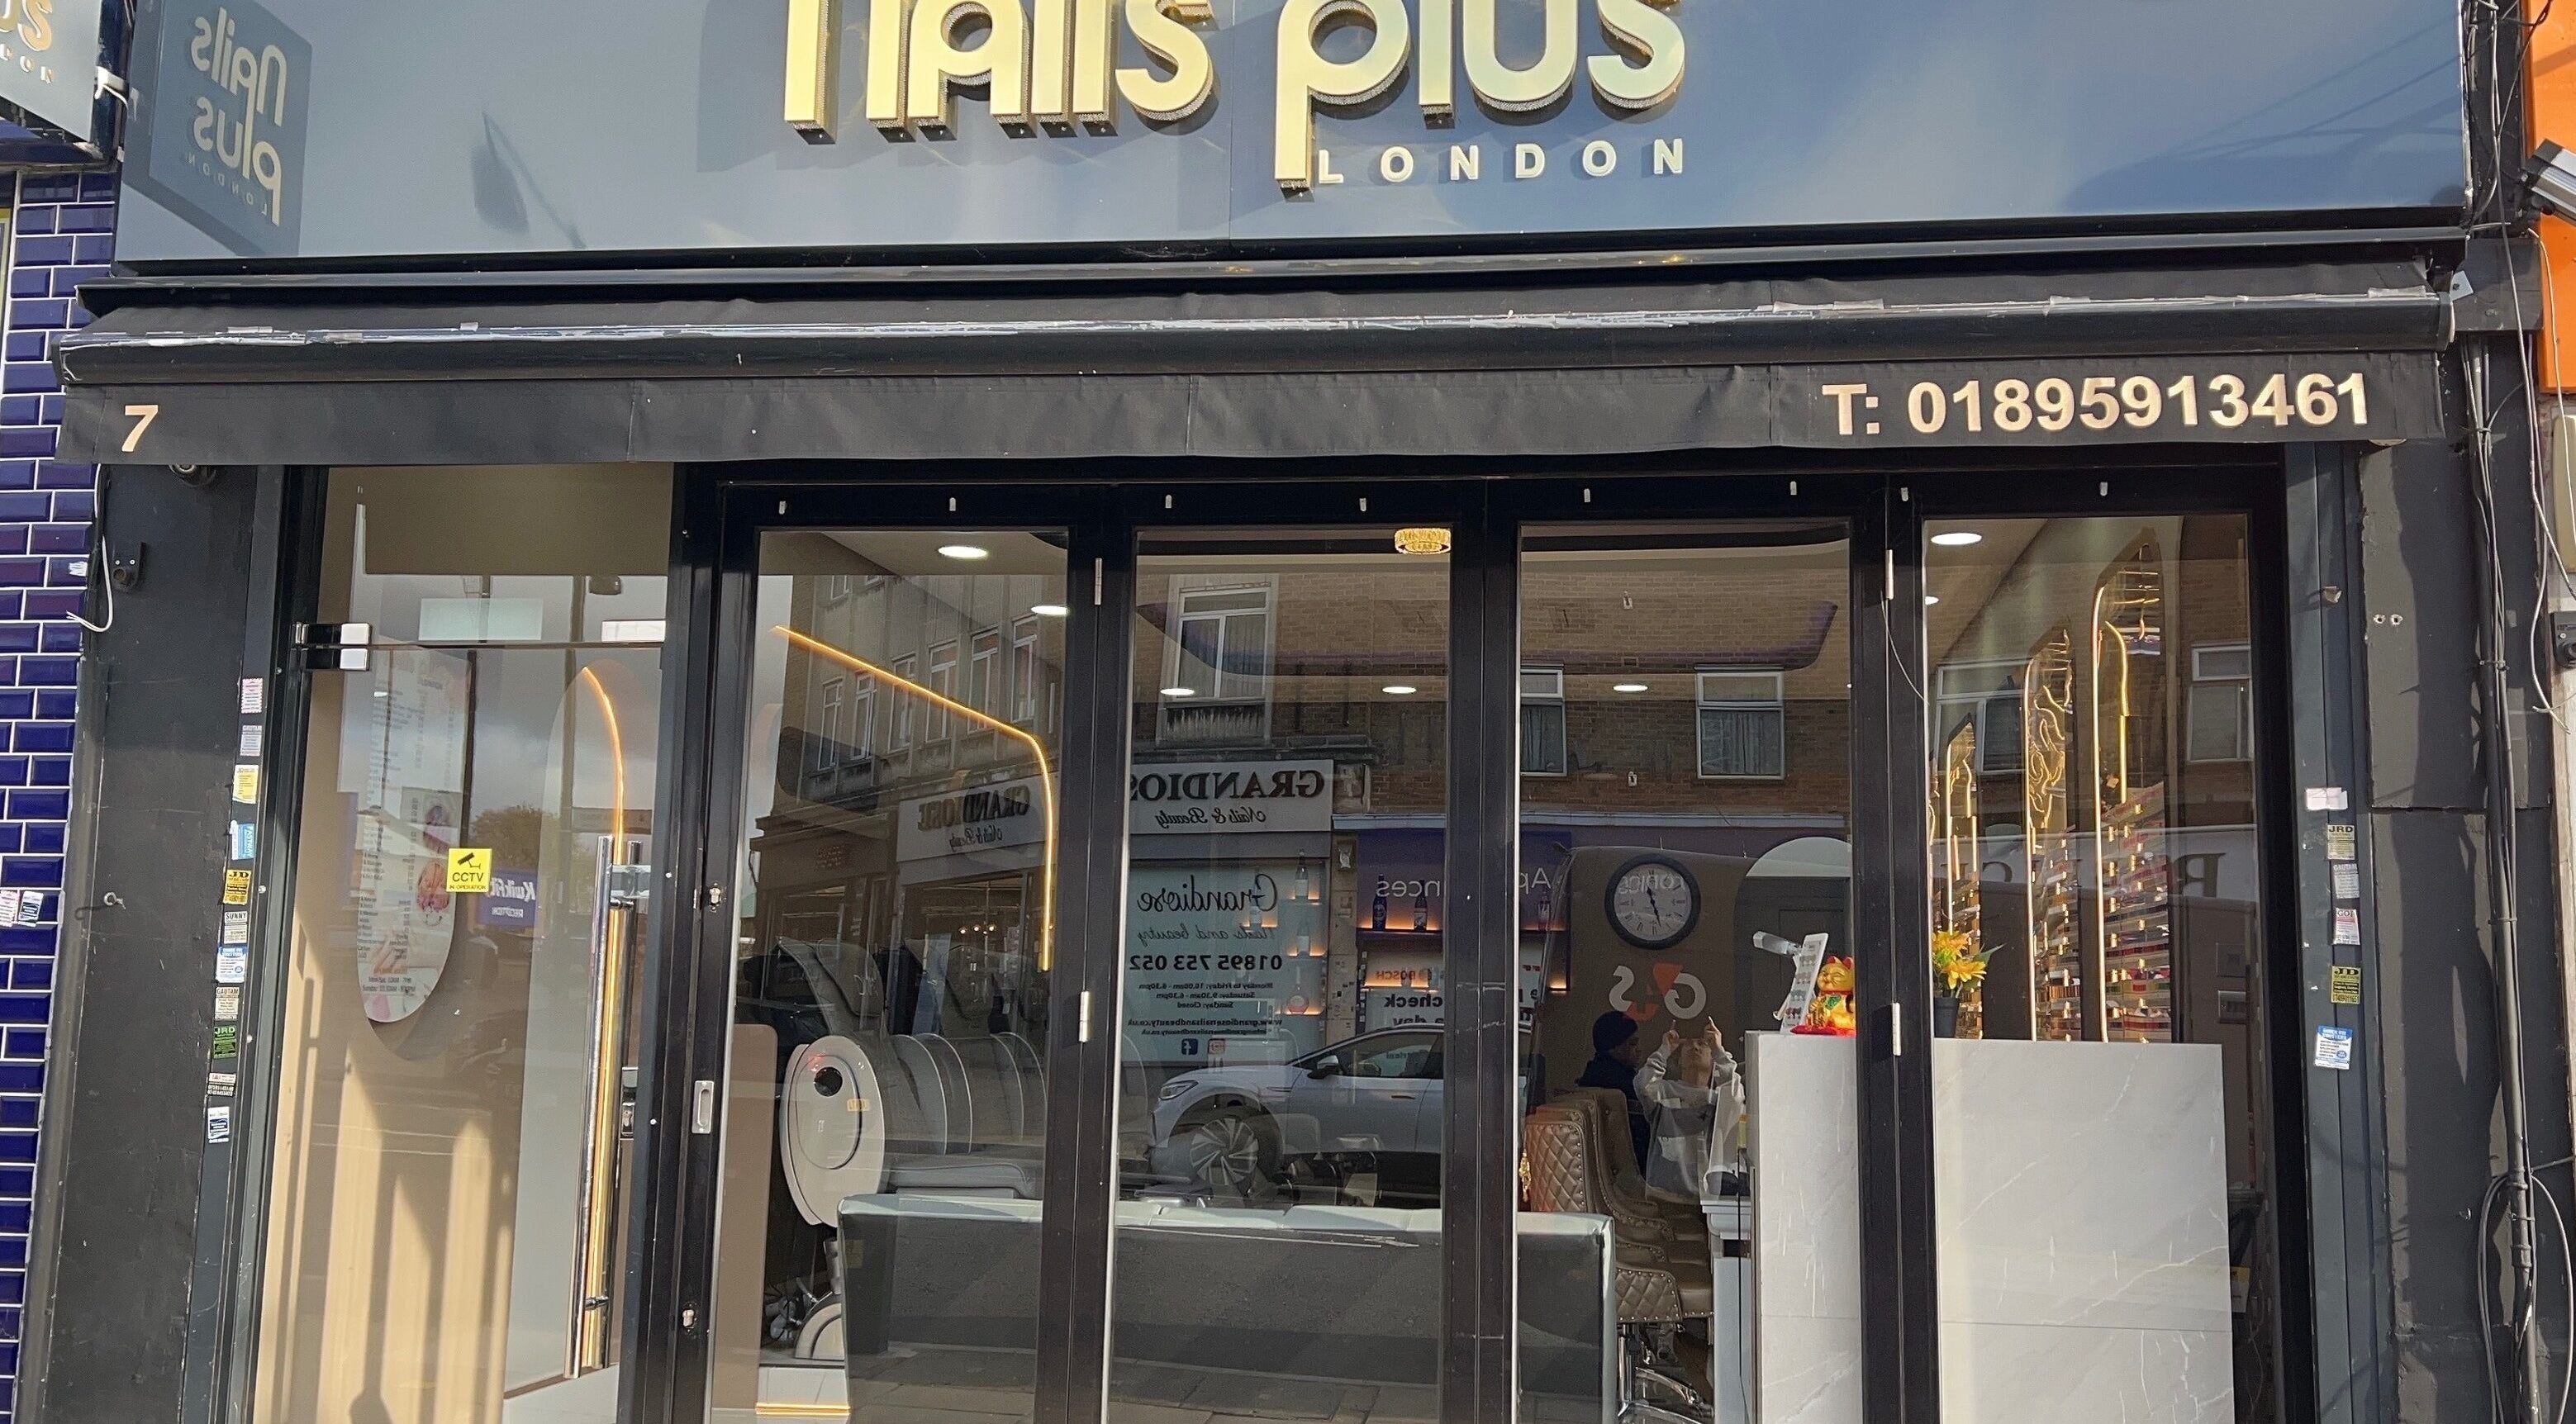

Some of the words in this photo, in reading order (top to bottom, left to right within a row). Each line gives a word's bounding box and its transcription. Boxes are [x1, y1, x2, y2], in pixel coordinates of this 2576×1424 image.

[1319, 138, 1684, 184] LONDON
[1822, 382, 1880, 435] T:
[1907, 373, 2368, 434] 01895913461
[121, 404, 159, 453] 7
[452, 871, 484, 882] CCTV
